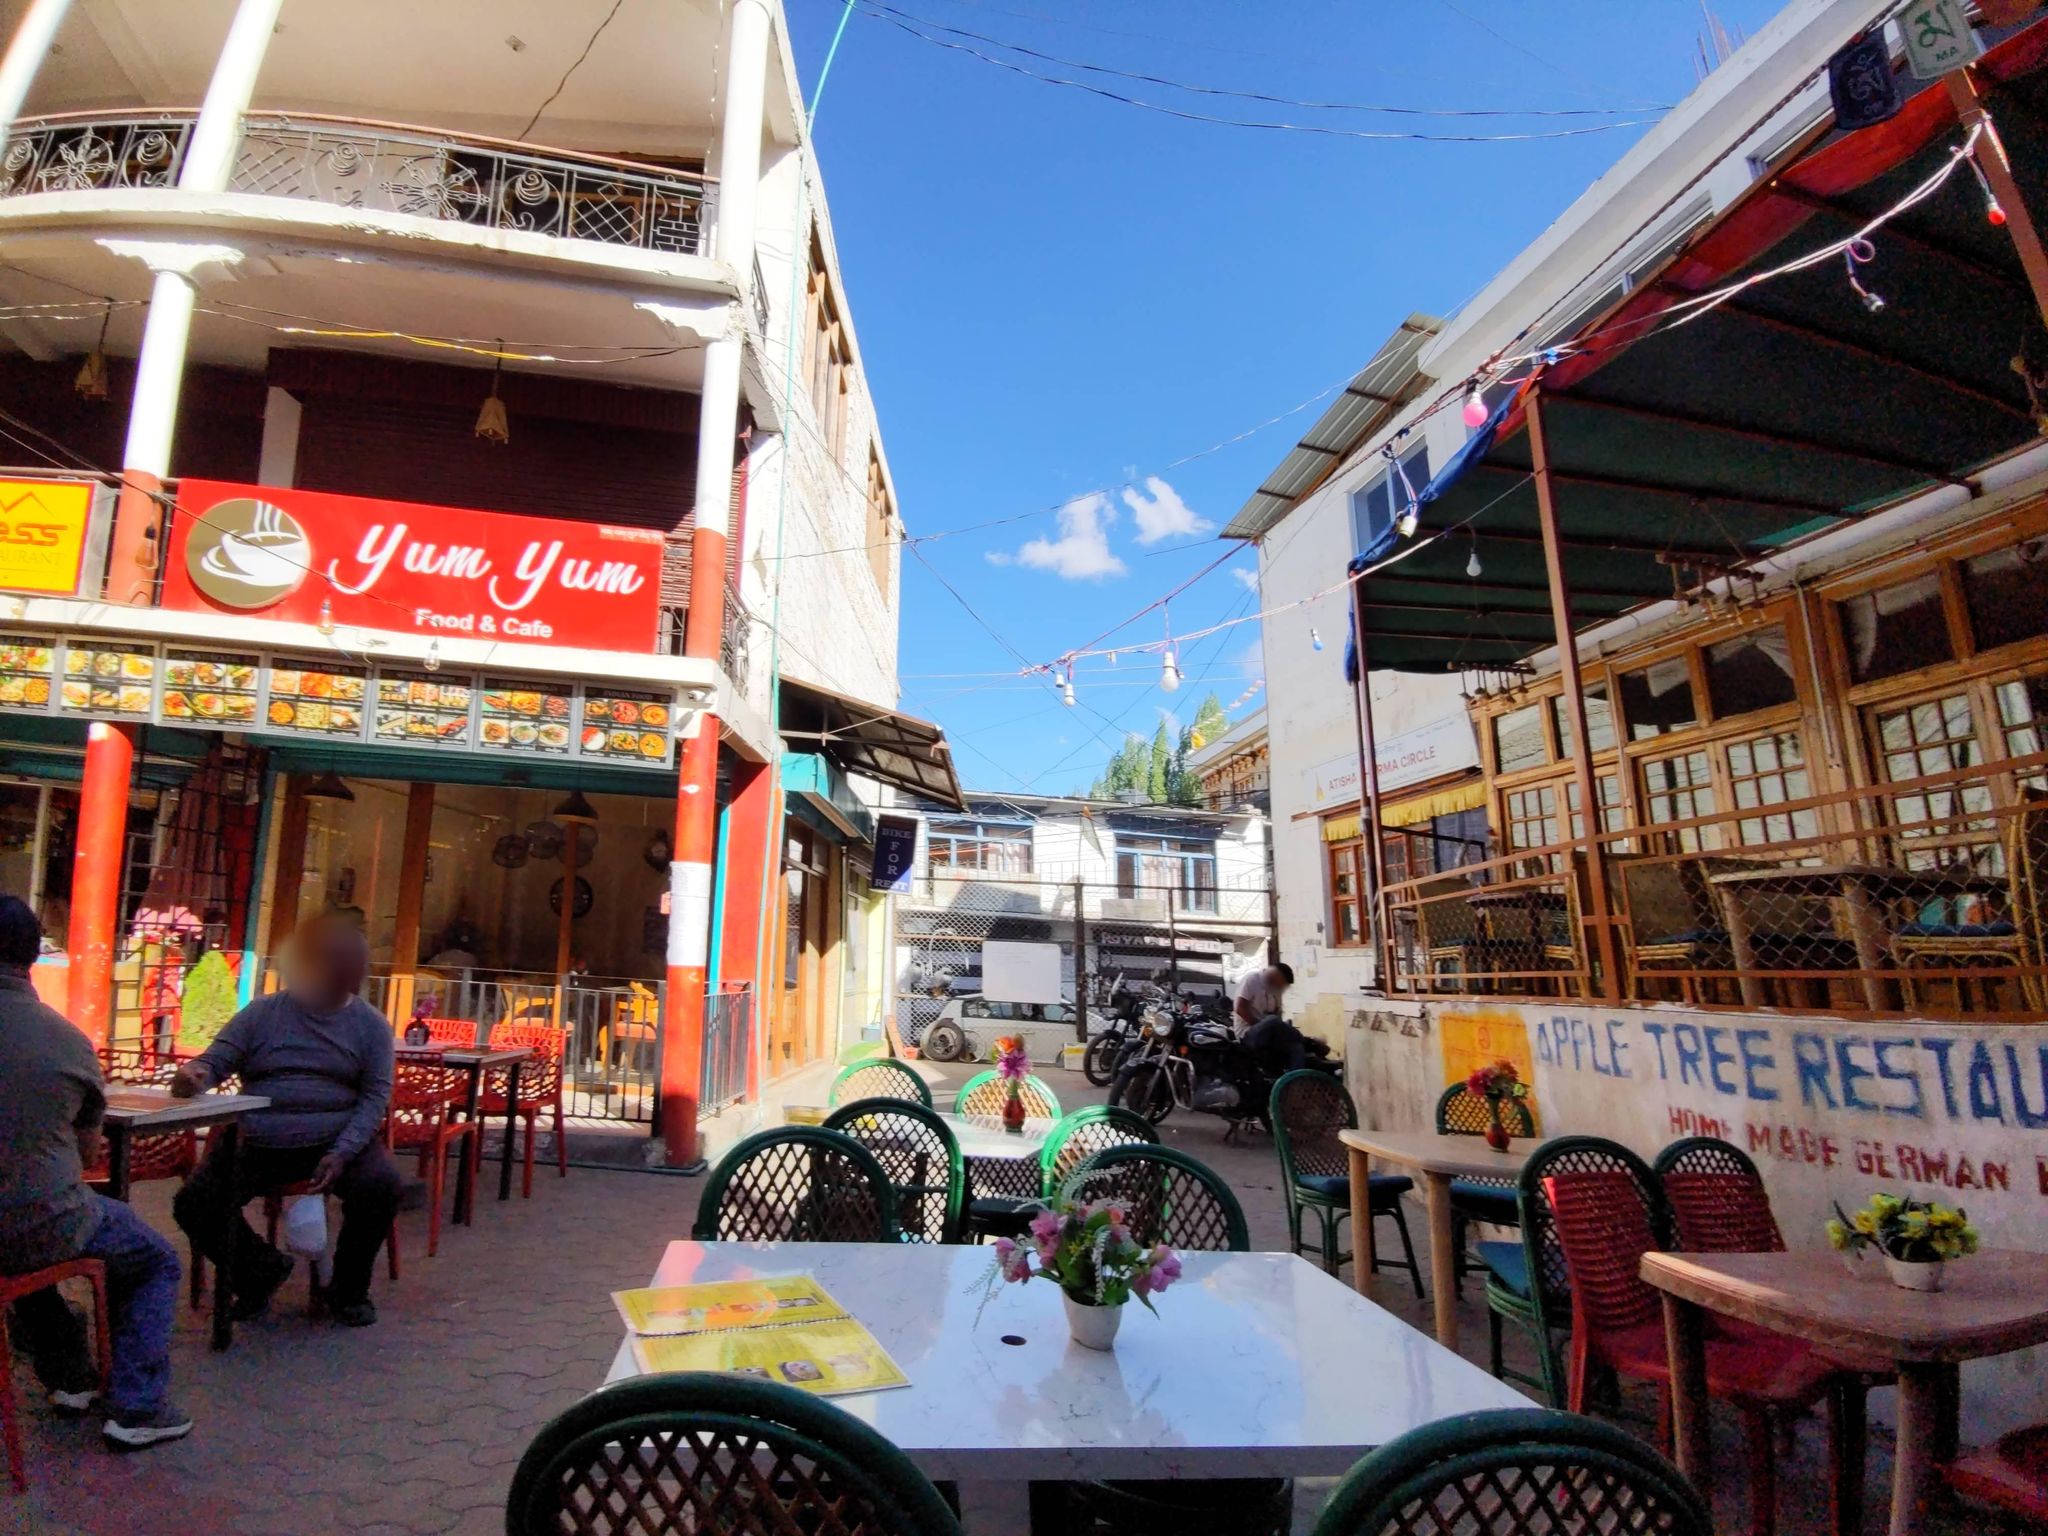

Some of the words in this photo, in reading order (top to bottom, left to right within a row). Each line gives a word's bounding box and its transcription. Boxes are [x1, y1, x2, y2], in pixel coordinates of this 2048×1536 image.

[327, 523, 493, 595] Yum
[488, 541, 645, 611] Yum
[415, 608, 475, 631] Food
[479, 614, 497, 633] &
[502, 617, 553, 638] Cafe
[1328, 772, 1357, 791] ATISHA
[1400, 745, 1437, 768] CIRCLE
[881, 828, 912, 839] BIKE
[887, 841, 900, 876] FOR
[1537, 1016, 1633, 1078] APPLE
[1643, 1022, 1782, 1102] TREE
[1744, 1122, 1840, 1170] MADE
[1856, 1138, 2010, 1192] GERMAN
